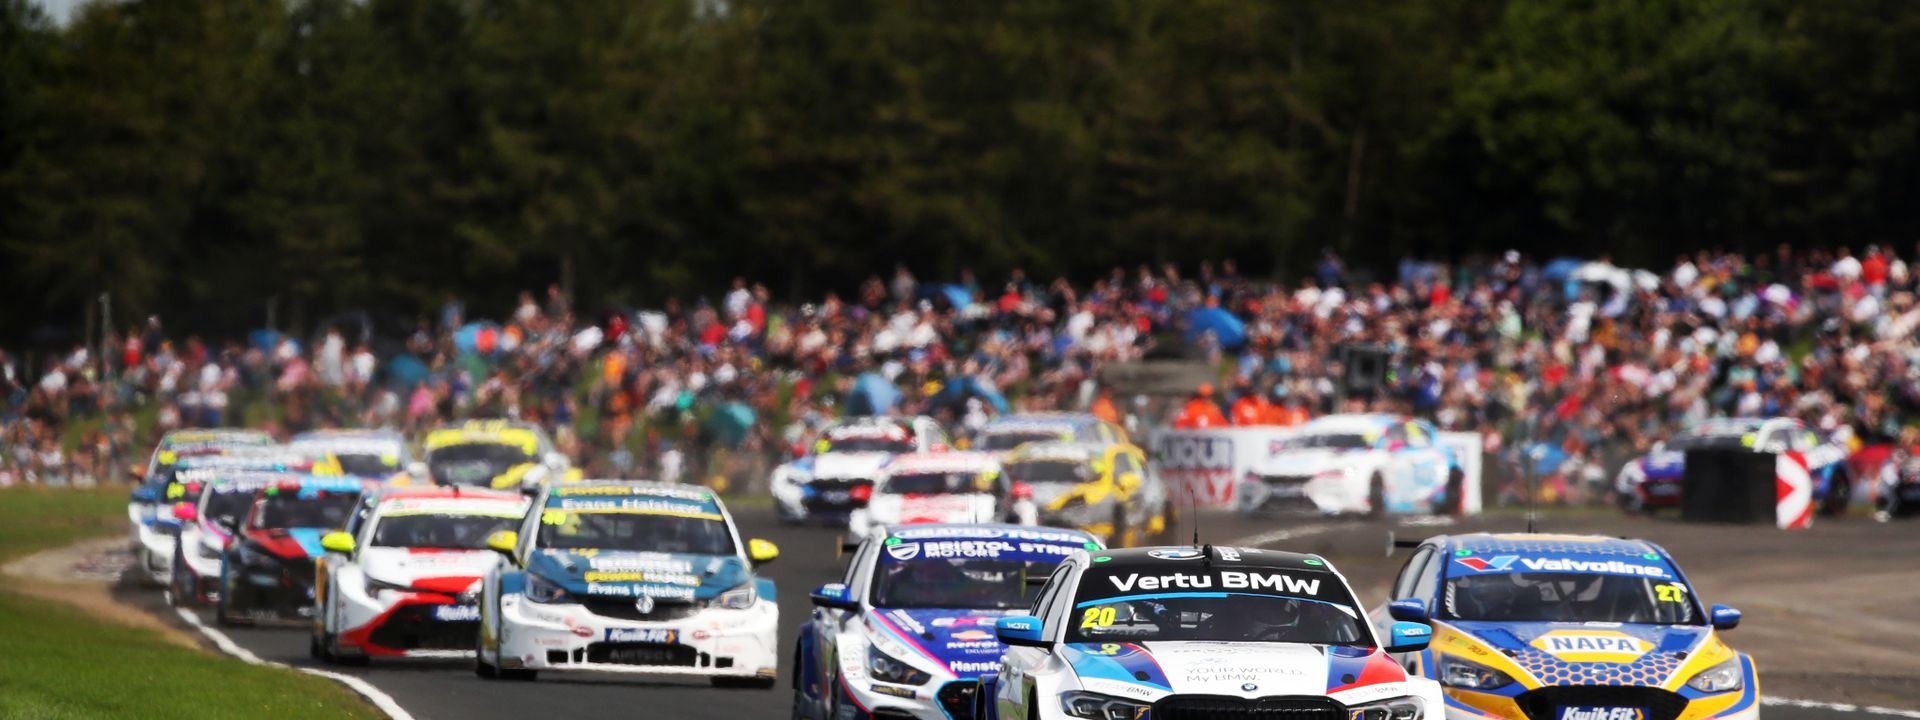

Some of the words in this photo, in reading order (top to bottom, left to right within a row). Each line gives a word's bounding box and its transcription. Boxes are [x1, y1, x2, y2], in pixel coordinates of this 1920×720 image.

[1004, 529, 1089, 543] Tools
[923, 541, 1017, 552] BRISTOL
[1019, 543, 1080, 556] STRE
[925, 549, 1001, 558] MOTORS
[1520, 557, 1665, 577] Valvoline
[1109, 573, 1212, 592] Vertu
[1221, 571, 1321, 596] BMW
[1654, 584, 1682, 602] 27
[1081, 607, 1116, 628] 20
[1550, 637, 1636, 652] NAPA
[1185, 666, 1234, 674] YOUR
[1186, 675, 1210, 683] My
